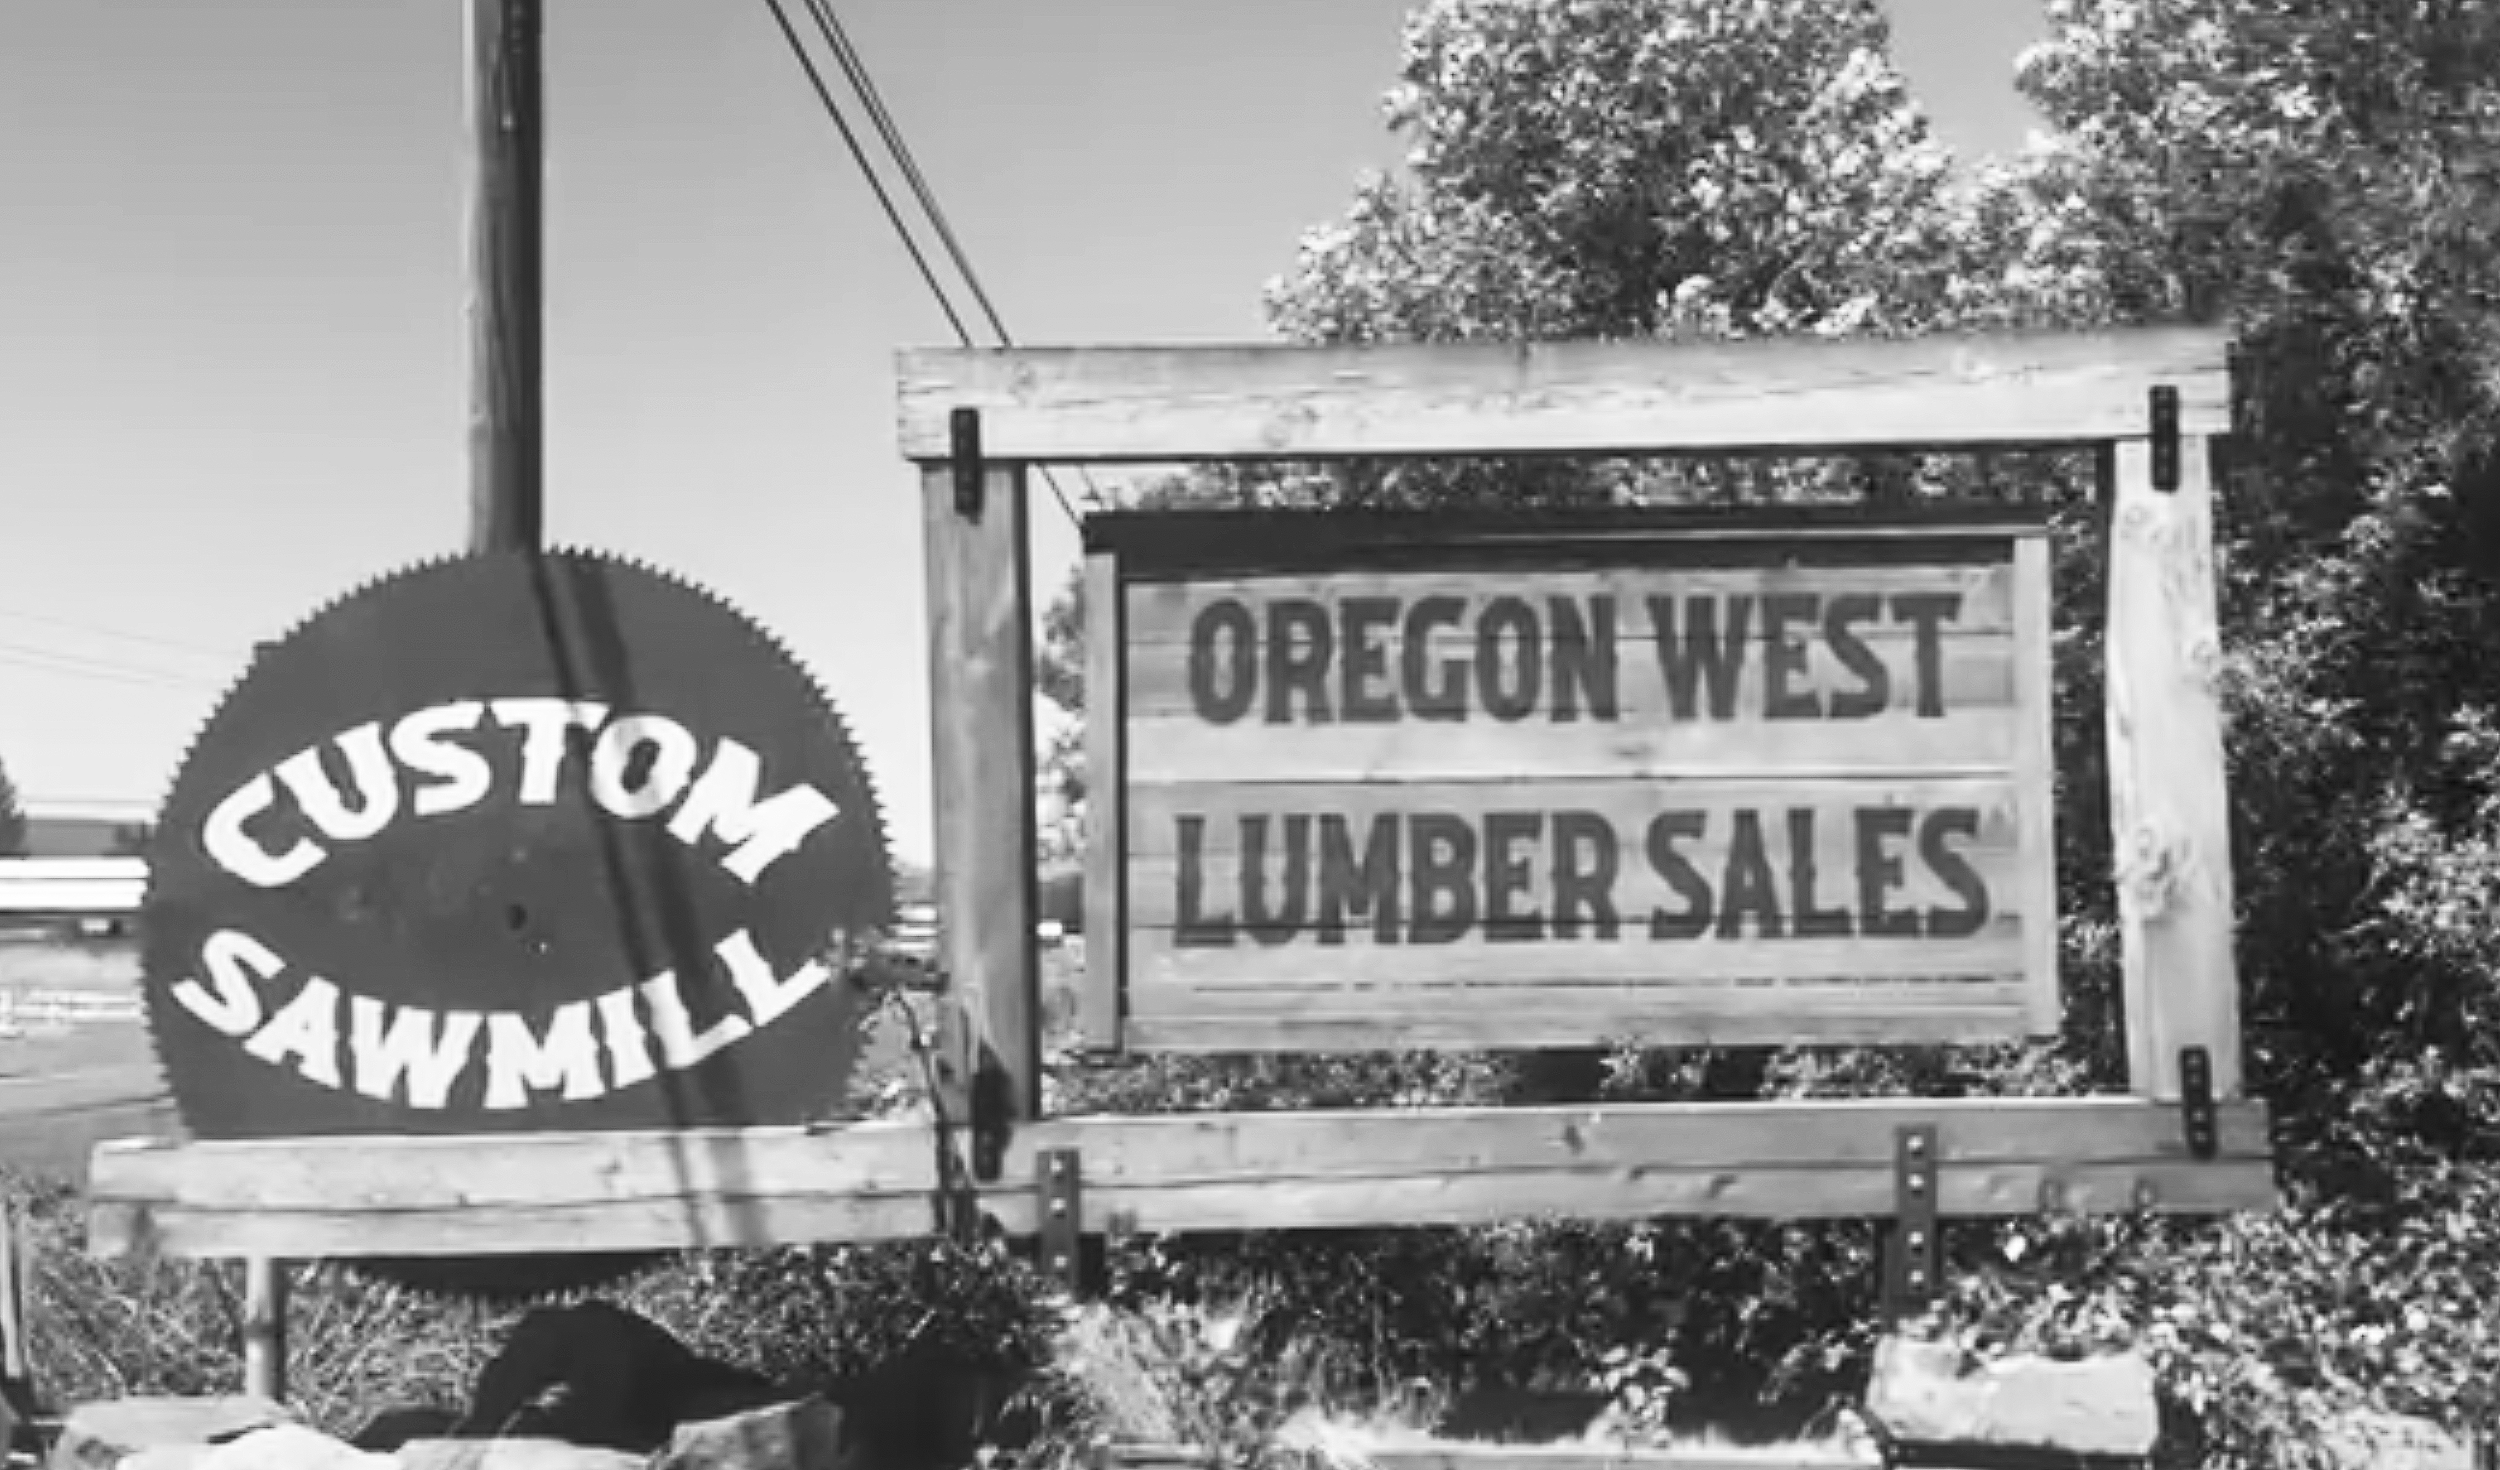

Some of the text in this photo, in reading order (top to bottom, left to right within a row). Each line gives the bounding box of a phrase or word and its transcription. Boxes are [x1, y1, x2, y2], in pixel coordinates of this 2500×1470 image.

[1188, 592, 1964, 726] OREGON WEST
[203, 697, 840, 888] CUSTOM
[1172, 807, 1991, 947] LUMBER SALES
[170, 928, 830, 1110] SAWMILL
